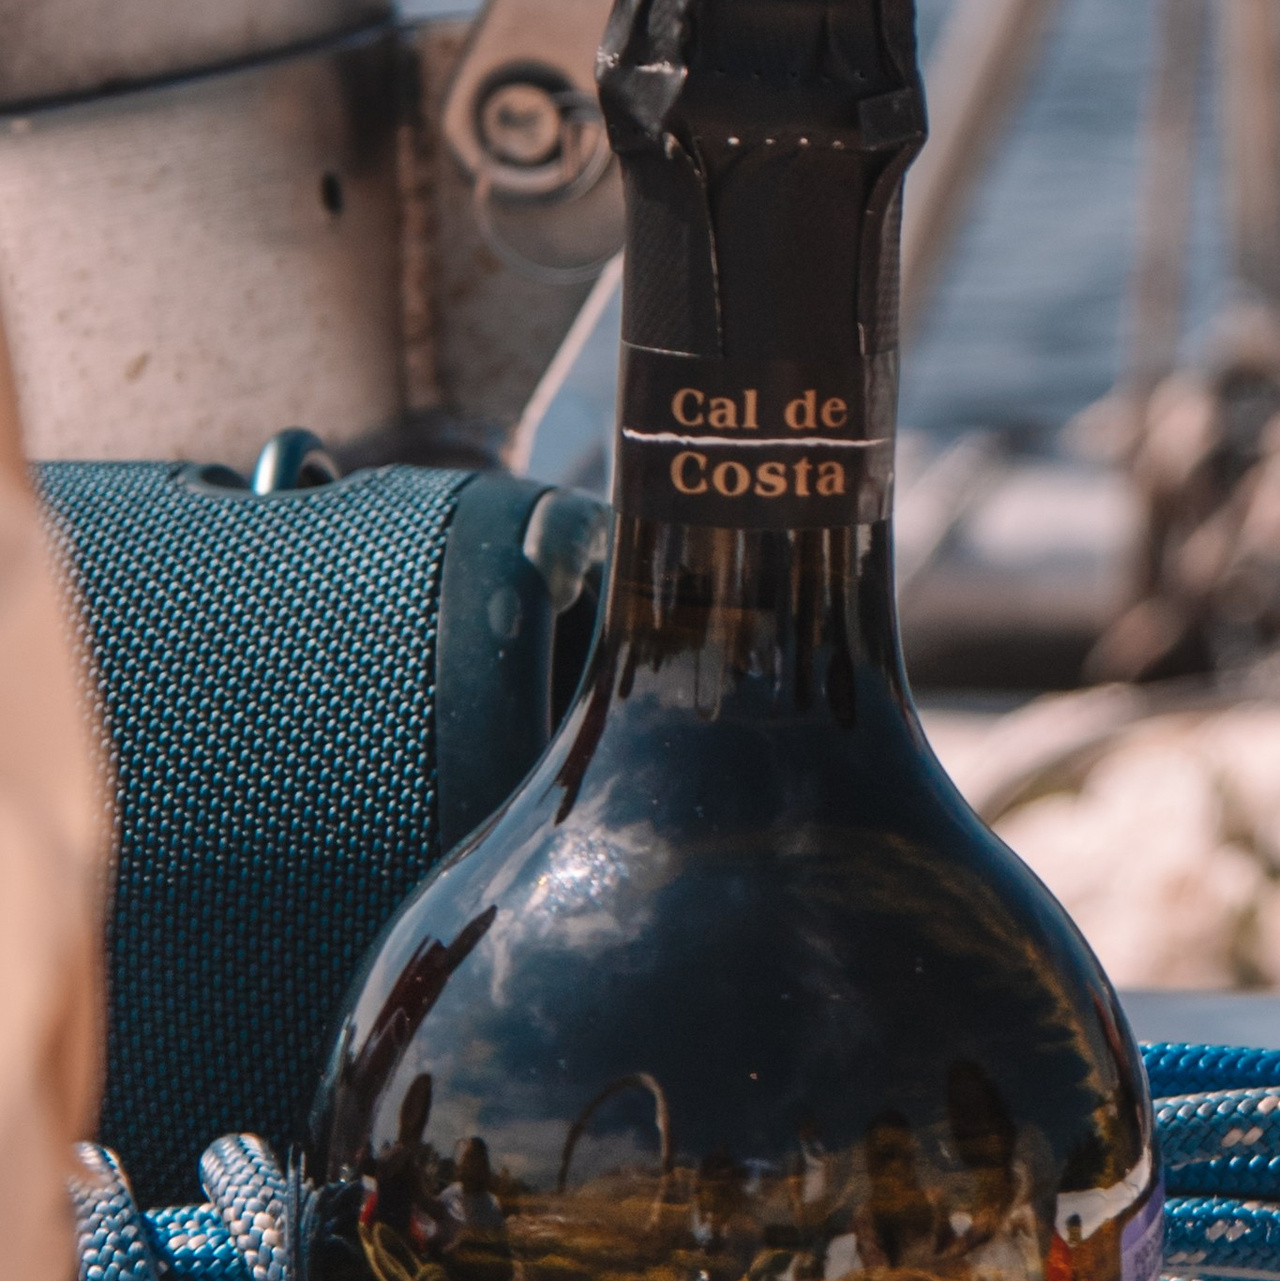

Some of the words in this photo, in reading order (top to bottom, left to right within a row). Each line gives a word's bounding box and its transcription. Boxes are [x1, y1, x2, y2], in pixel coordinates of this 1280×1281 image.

[671, 388, 758, 428] Cal
[784, 389, 849, 429] de
[670, 451, 846, 496] Costa
